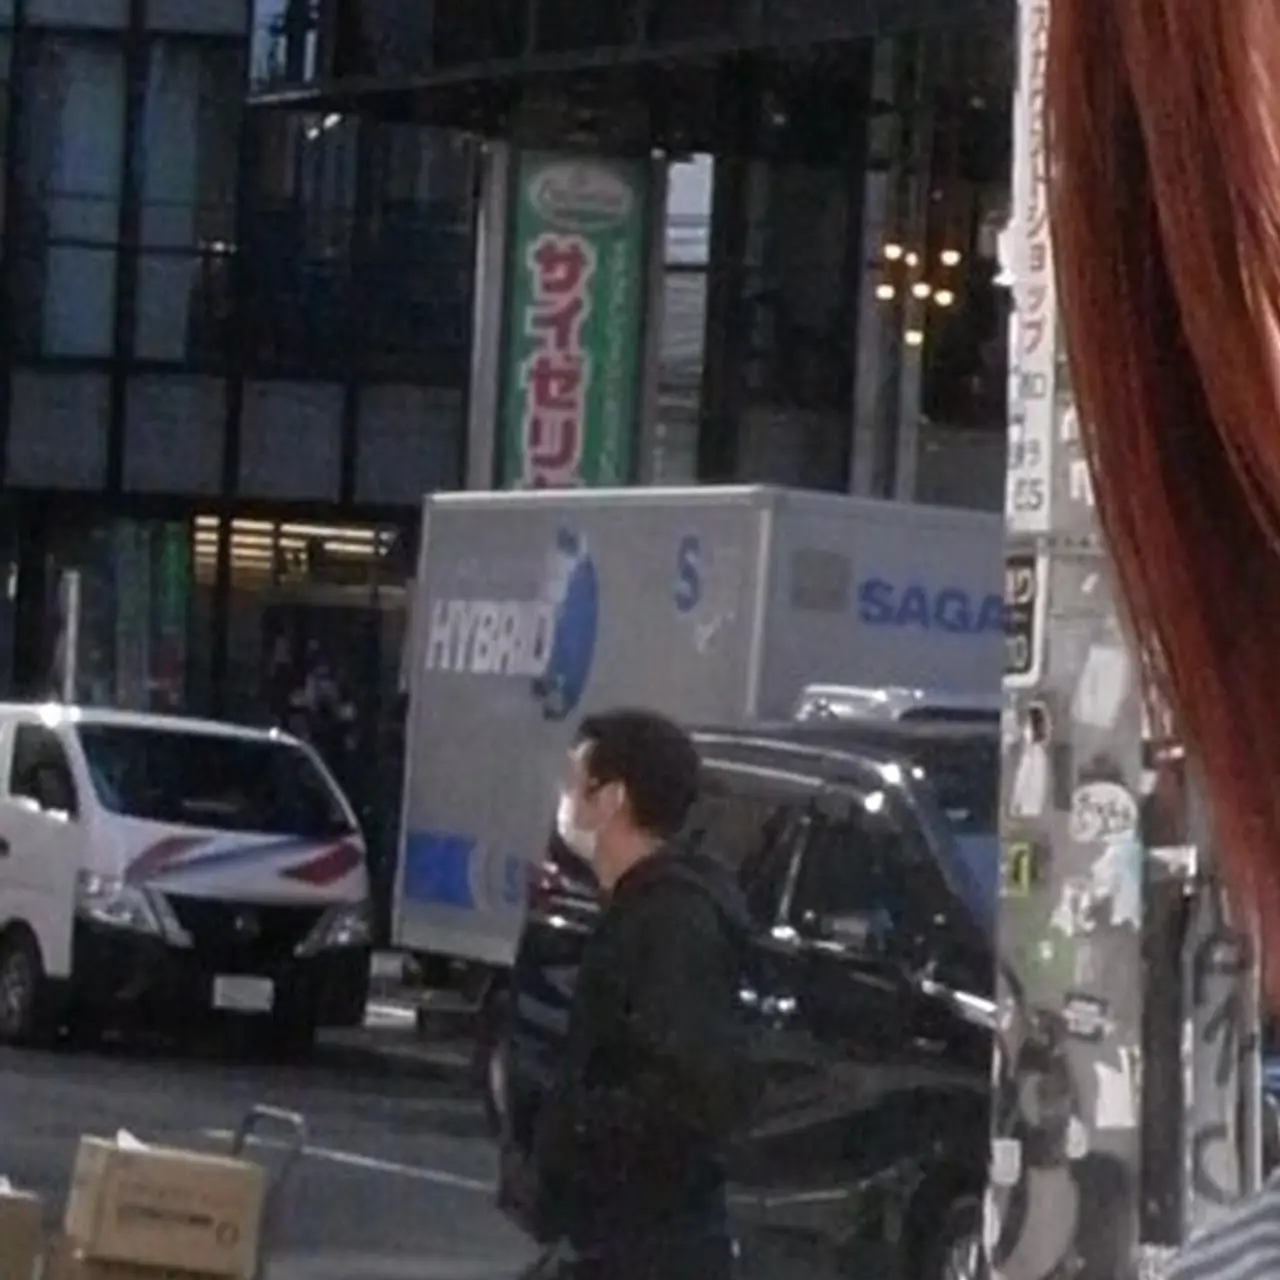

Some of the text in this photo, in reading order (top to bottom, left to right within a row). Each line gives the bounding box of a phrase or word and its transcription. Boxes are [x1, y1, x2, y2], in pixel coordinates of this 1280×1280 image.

[520, 233, 597, 490] サイゼリ
[424, 599, 557, 677] HYBRID
